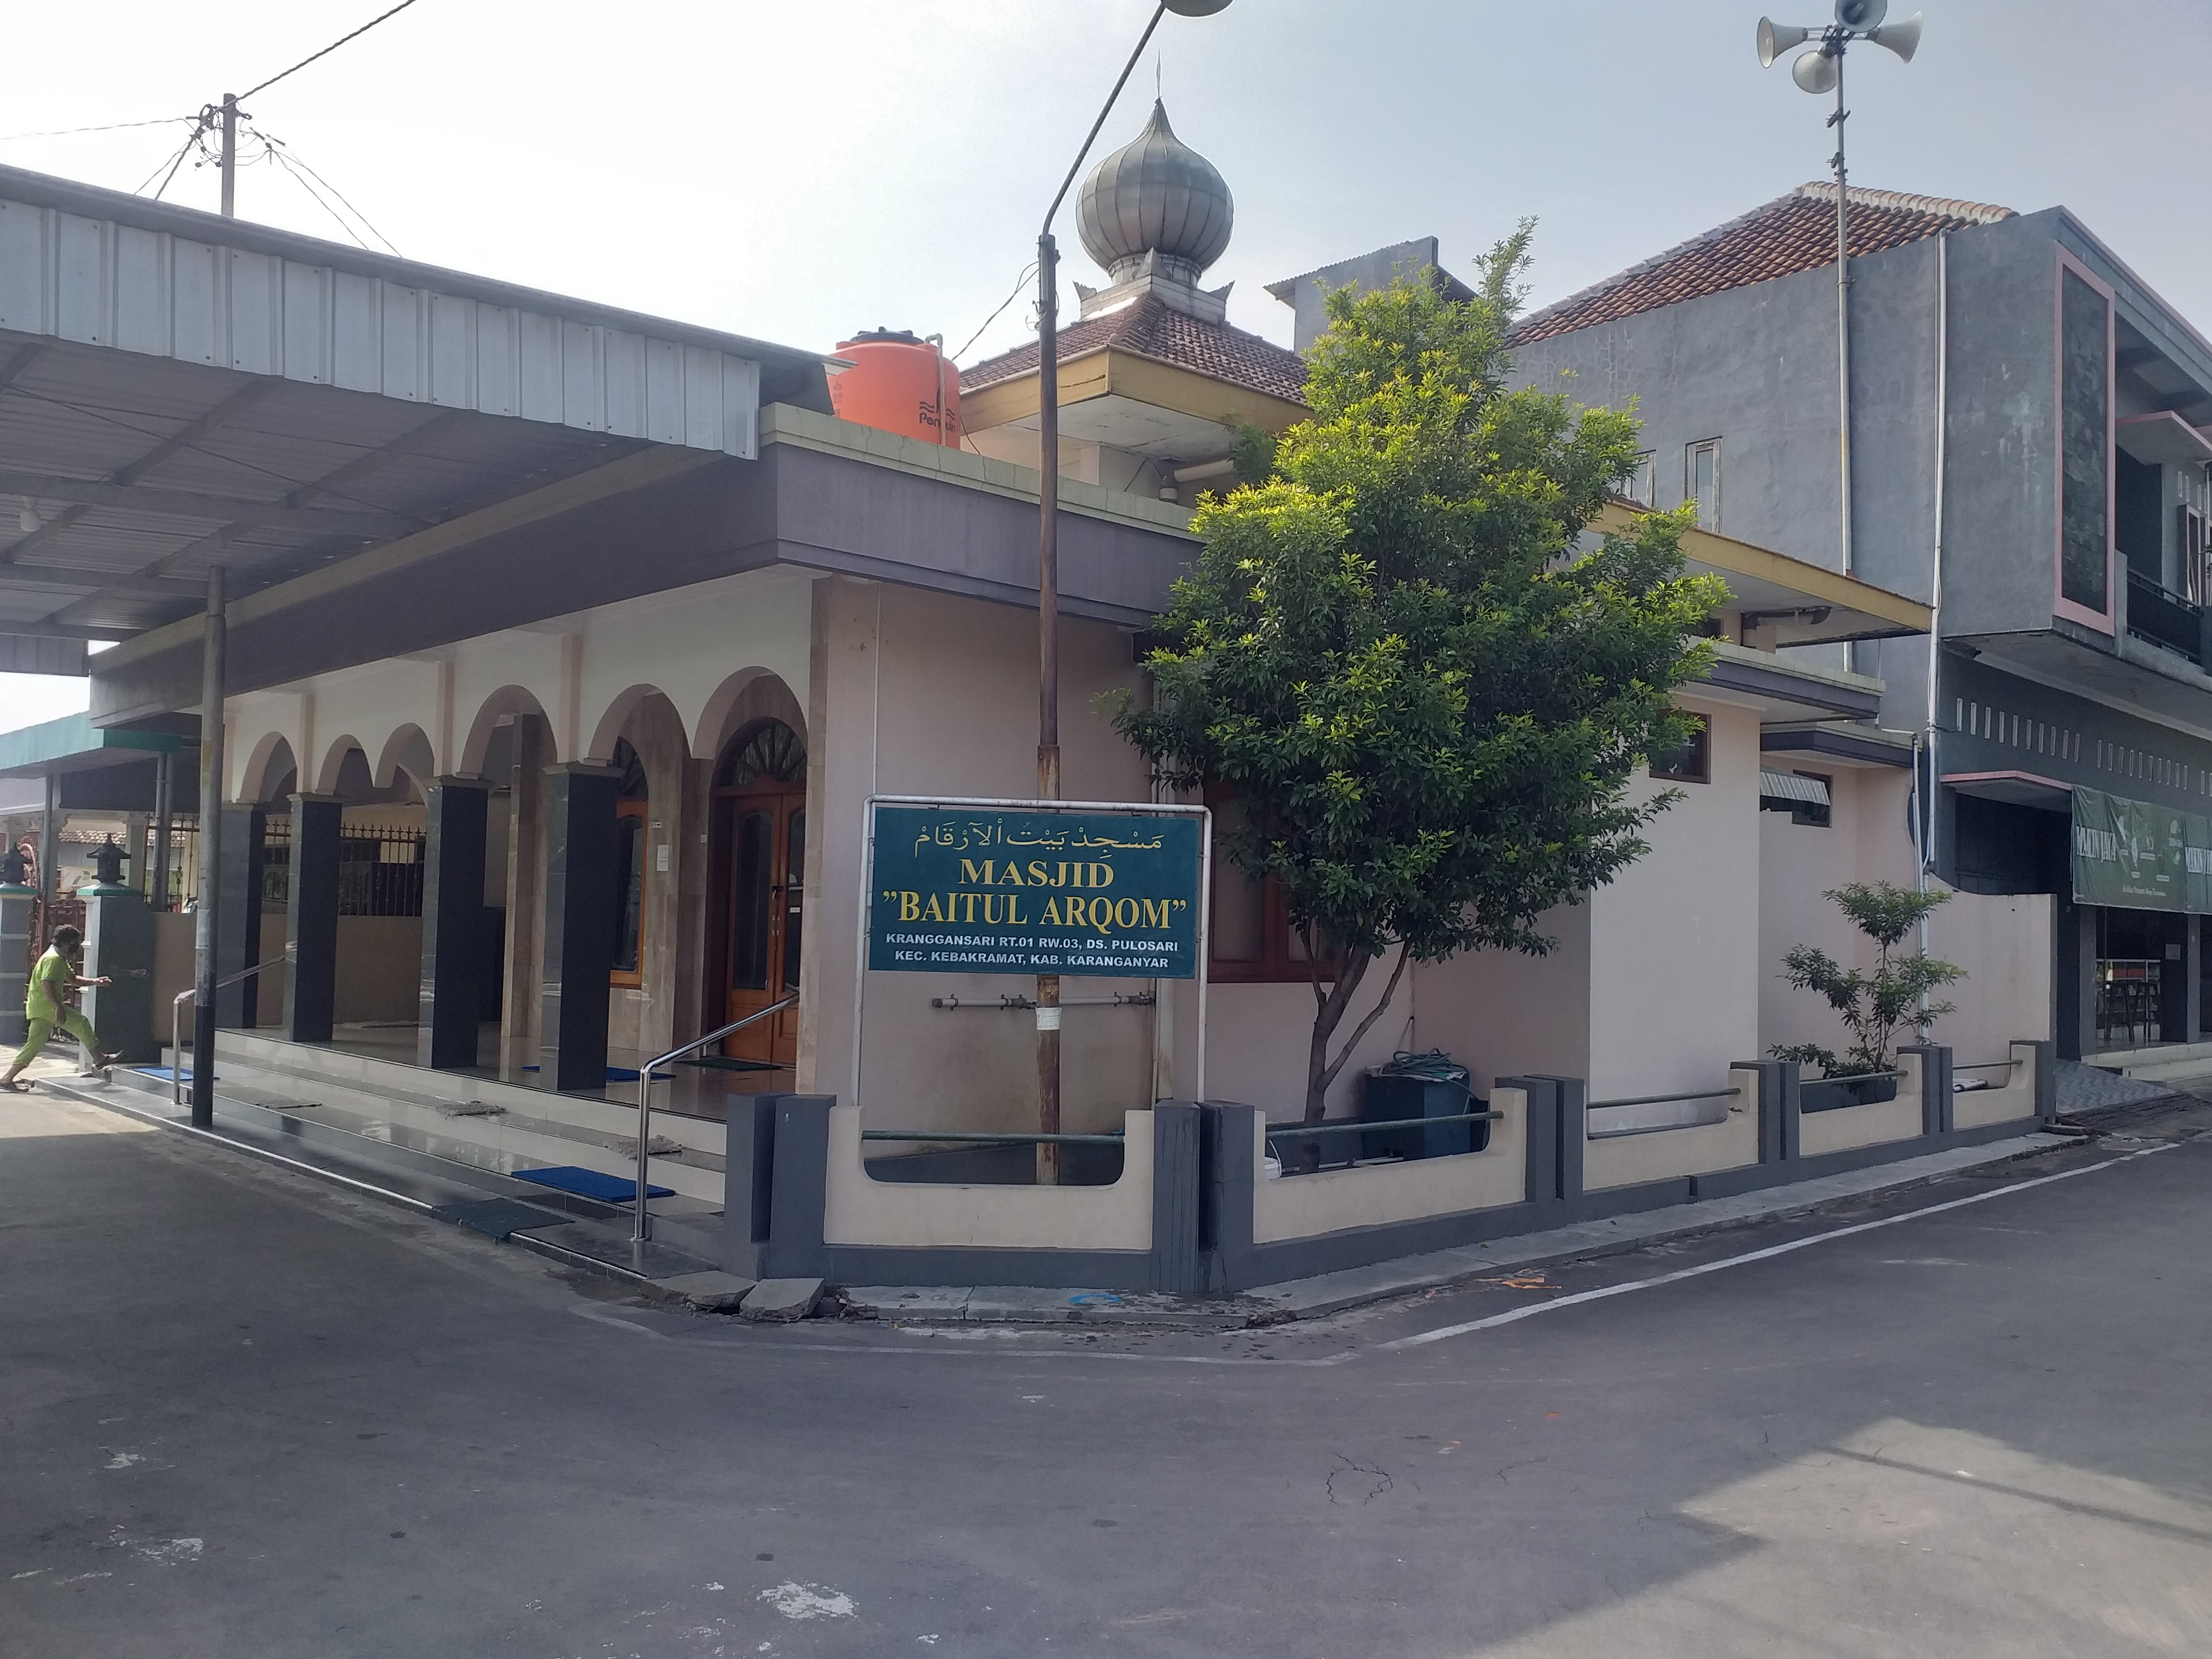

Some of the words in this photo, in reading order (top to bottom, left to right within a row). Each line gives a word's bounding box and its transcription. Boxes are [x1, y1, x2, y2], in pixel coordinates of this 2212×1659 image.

[919, 412, 955, 434] Penuin
[2100, 831, 2117, 863] JAYA
[957, 858, 1114, 888] MASJID
[886, 933, 995, 946] KRANGGANSARI
[999, 937, 1033, 947] RT.01
[1038, 938, 1082, 951] RW.03,
[1086, 939, 1108, 949] DS.
[1112, 940, 1178, 952] PULOSARI
[895, 950, 927, 961] KEC.
[931, 951, 1027, 966] KEBAKRAMAT,
[1030, 954, 1063, 965] KAB.
[1066, 955, 1169, 968] KARANGANYAR
